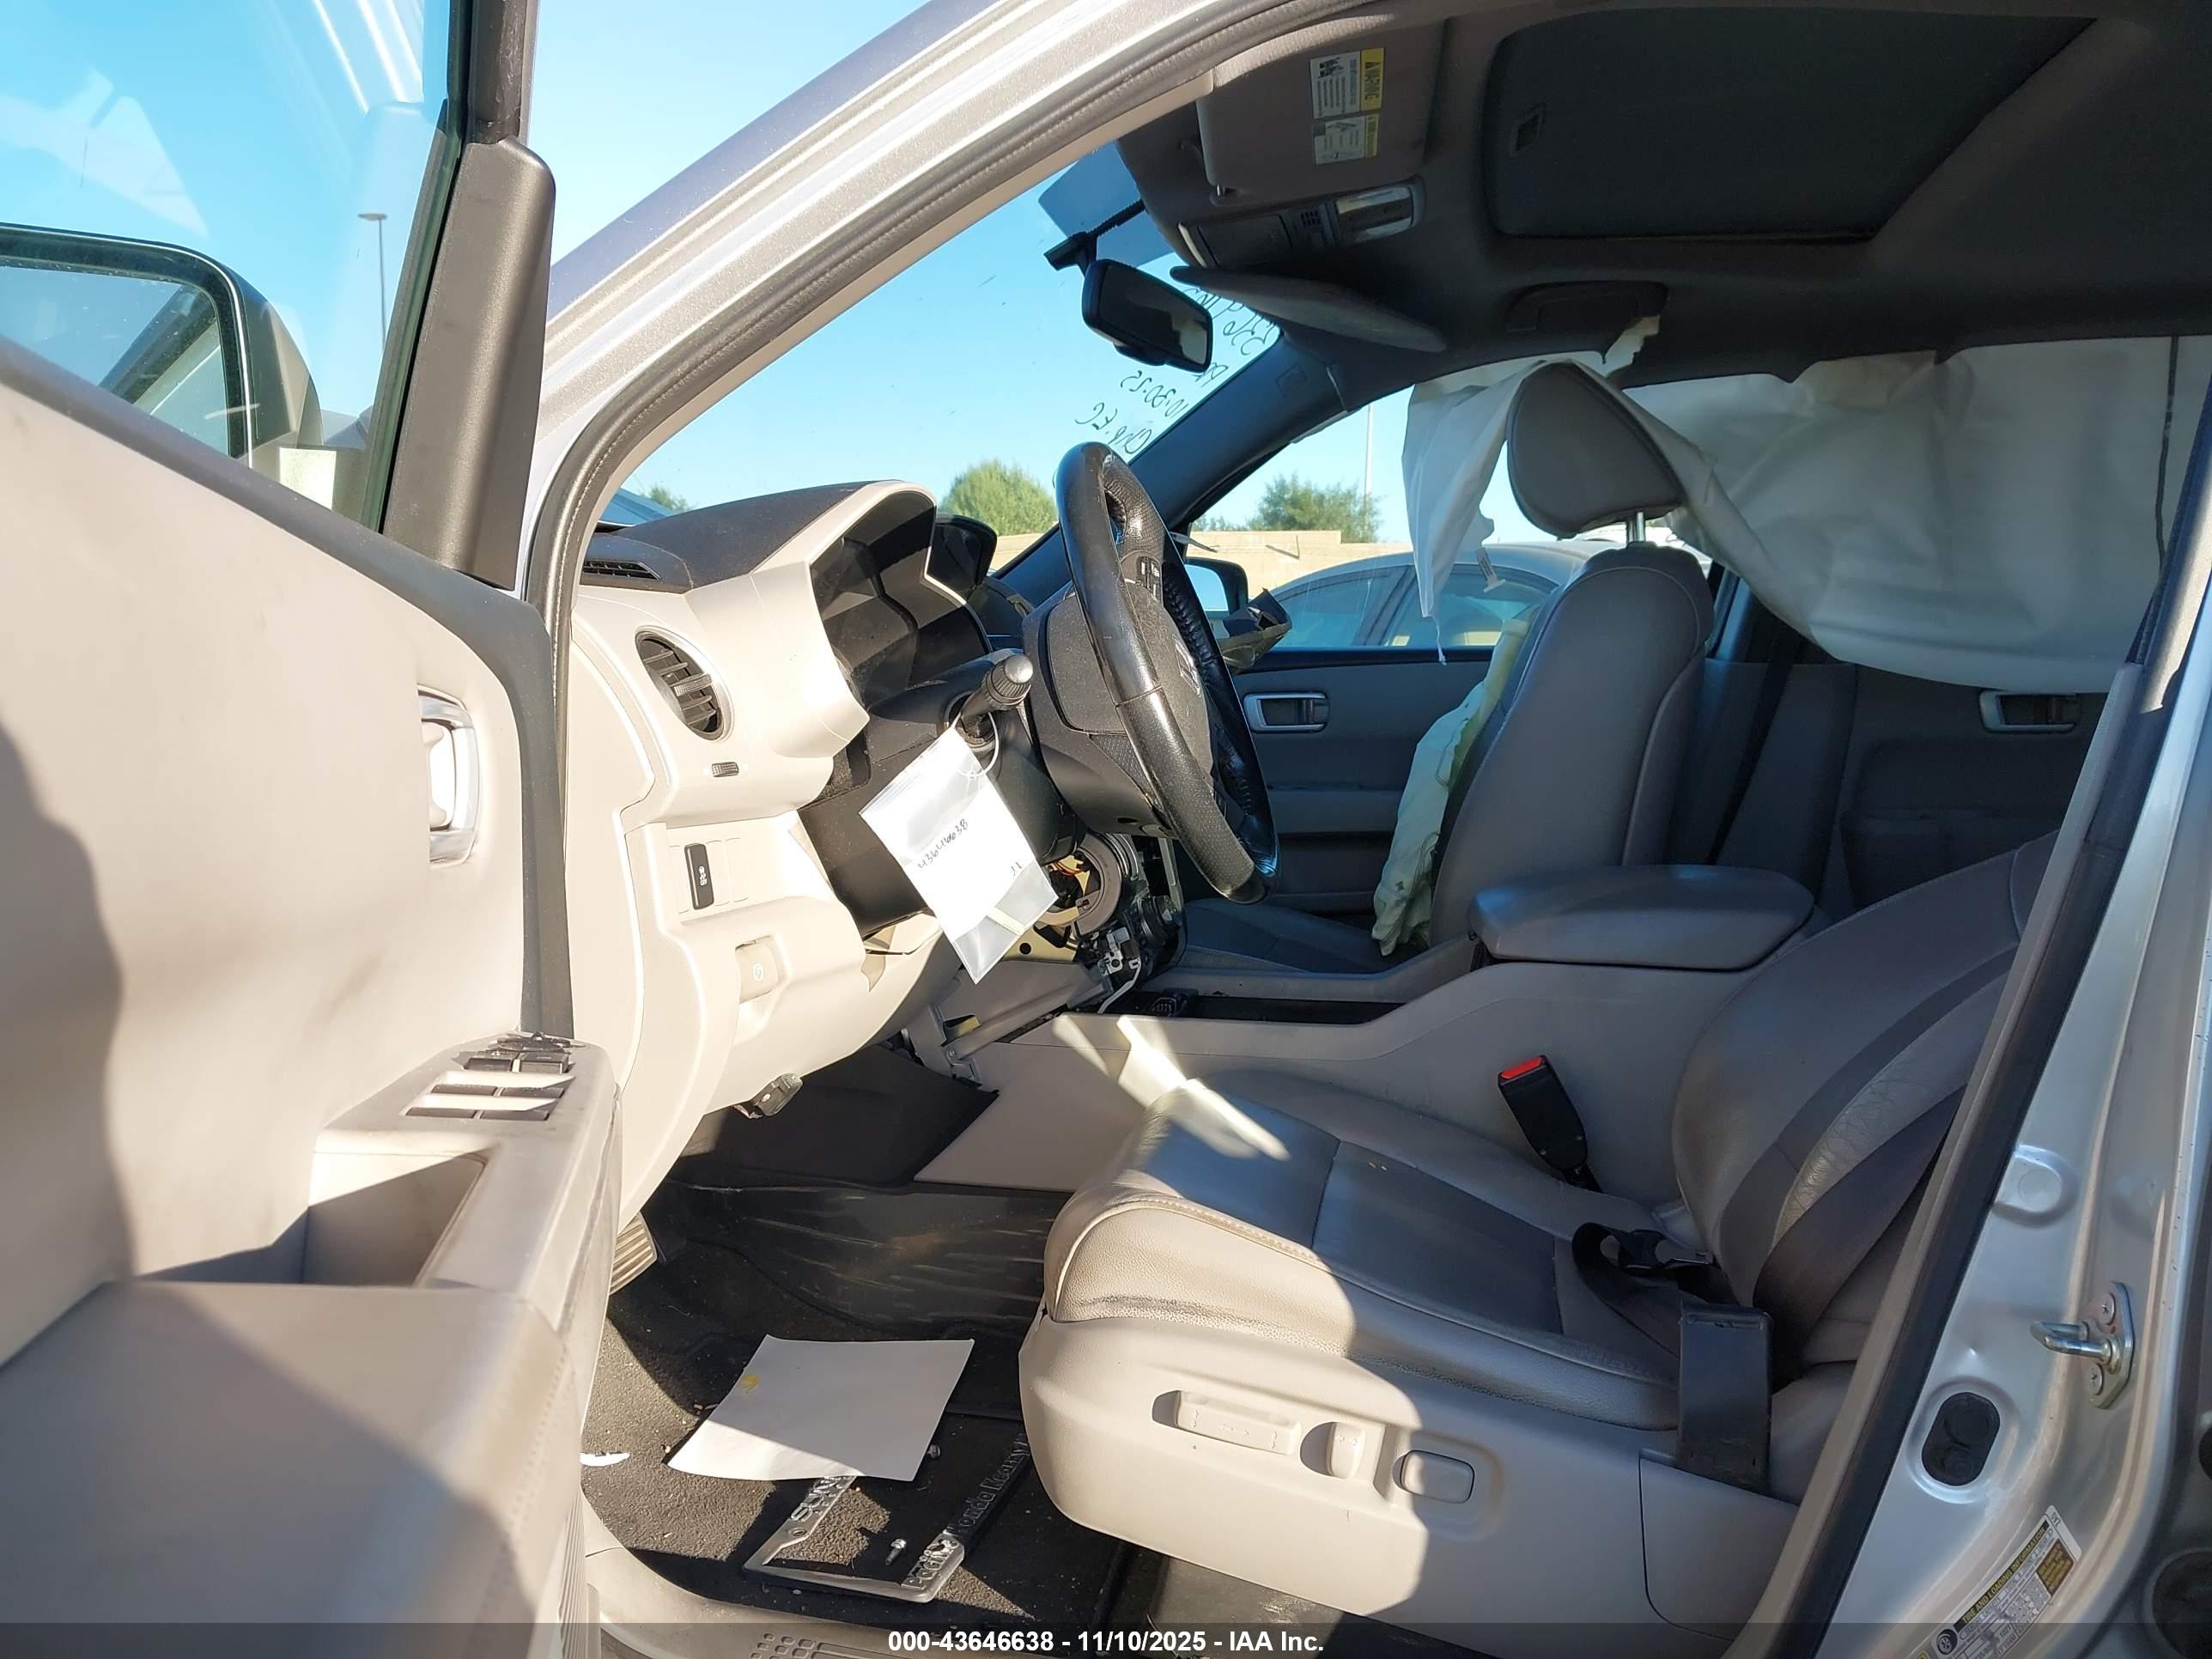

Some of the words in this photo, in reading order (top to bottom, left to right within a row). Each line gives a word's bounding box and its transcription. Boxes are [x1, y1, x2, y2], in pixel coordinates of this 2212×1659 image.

[790, 1476, 842, 1522] SUN
[1975, 1595, 1990, 1614] AND
[1988, 1568, 2013, 1598] LOADING
[2011, 1526, 2046, 1573] INFORMATION
